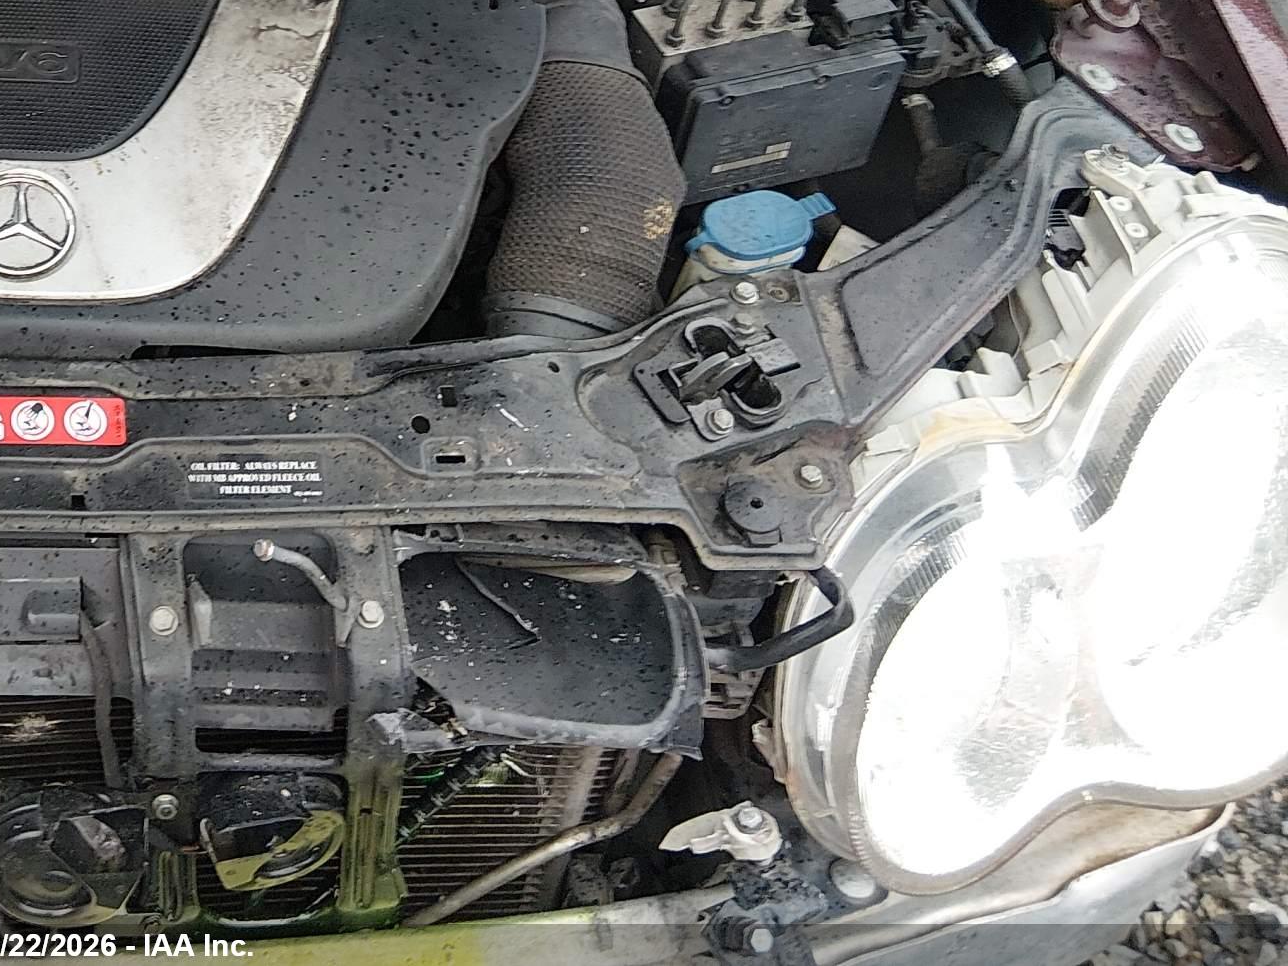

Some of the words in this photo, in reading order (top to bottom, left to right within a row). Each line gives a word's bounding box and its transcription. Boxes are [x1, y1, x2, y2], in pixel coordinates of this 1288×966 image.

[190, 461, 207, 471] OIL
[244, 461, 278, 471] ALWAYS
[278, 461, 318, 471] REPLACE
[187, 473, 212, 483] WITH
[227, 473, 272, 482] APPROVED
[272, 472, 305, 482] FLEECE
[305, 472, 323, 481] OIL
[219, 485, 250, 494] FILTER
[250, 485, 293, 494] ELEMENT
